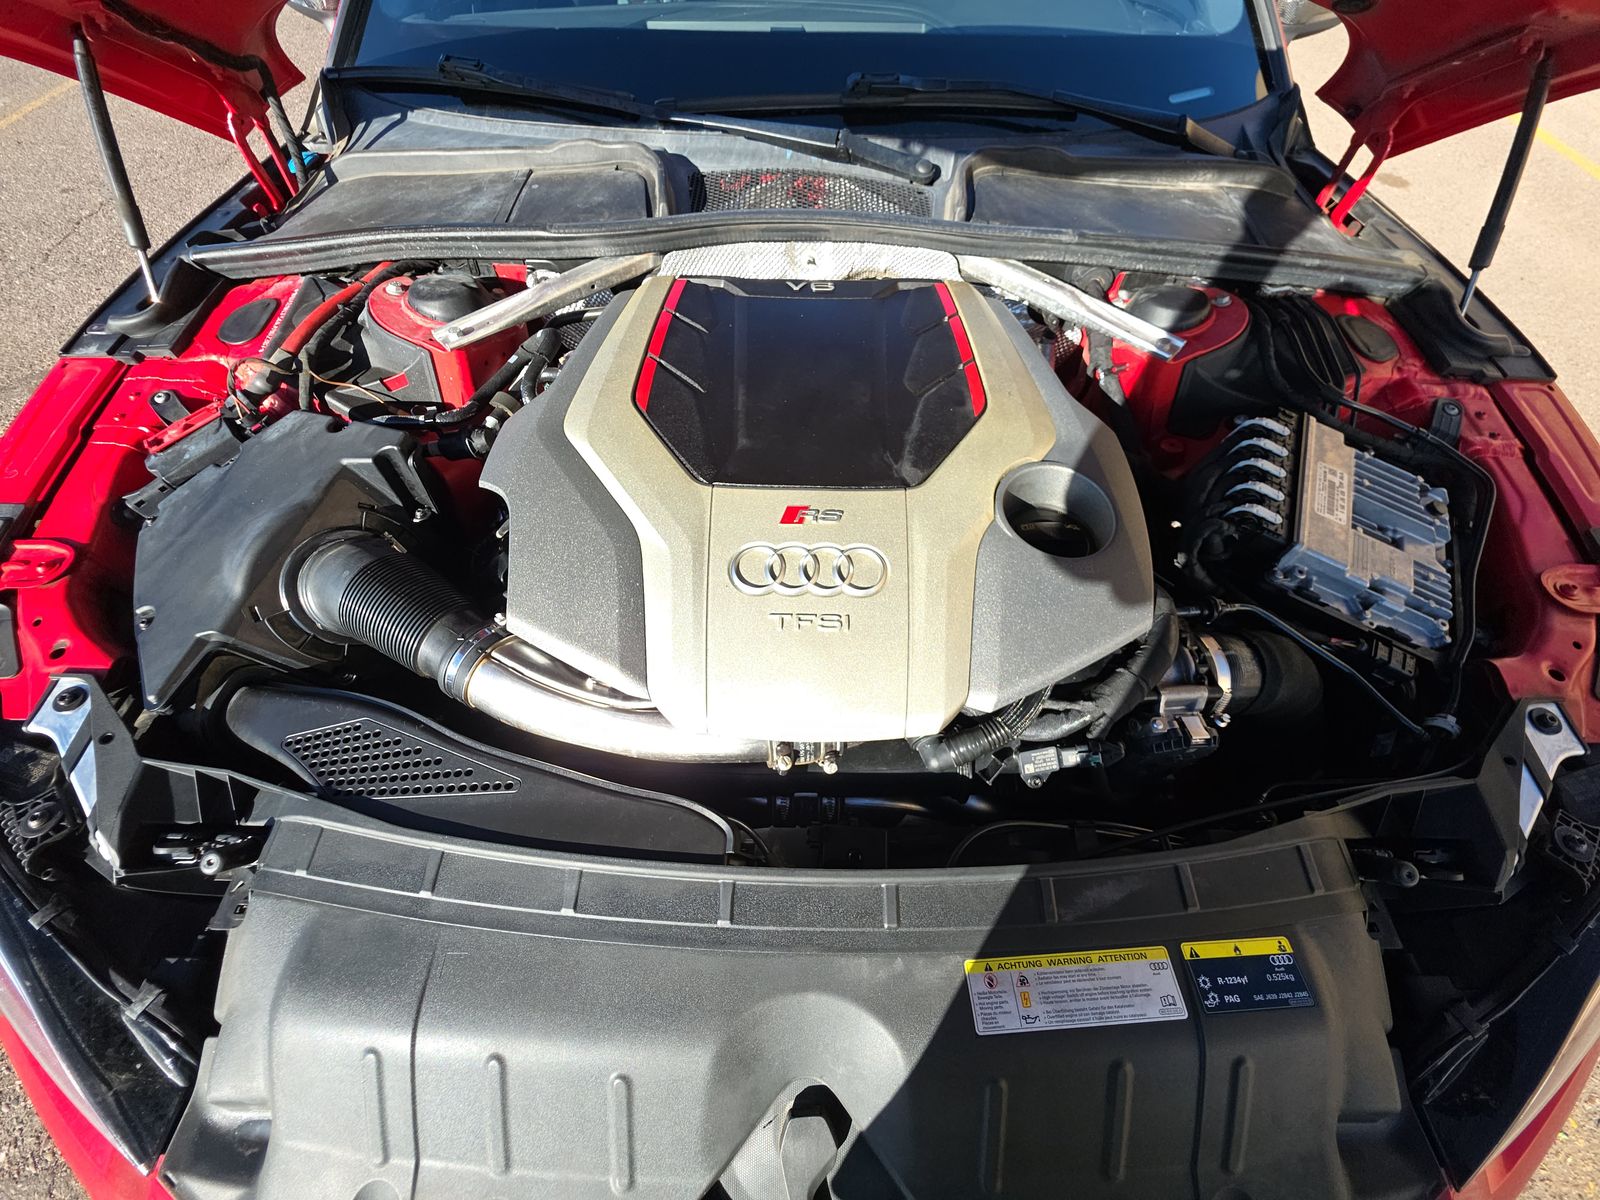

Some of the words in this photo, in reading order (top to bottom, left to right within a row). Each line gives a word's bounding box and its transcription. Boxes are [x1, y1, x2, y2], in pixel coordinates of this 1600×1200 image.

[785, 281, 835, 292] V6
[784, 506, 844, 523] RS
[769, 612, 851, 630] TFSI
[997, 960, 1042, 970] ACHTUNG
[1046, 957, 1093, 966] WARNING
[1097, 953, 1147, 963] ATTENTION
[1217, 975, 1249, 985] R-1234yf
[1266, 973, 1295, 982] 0.525kg
[1224, 994, 1240, 1003] PAG
